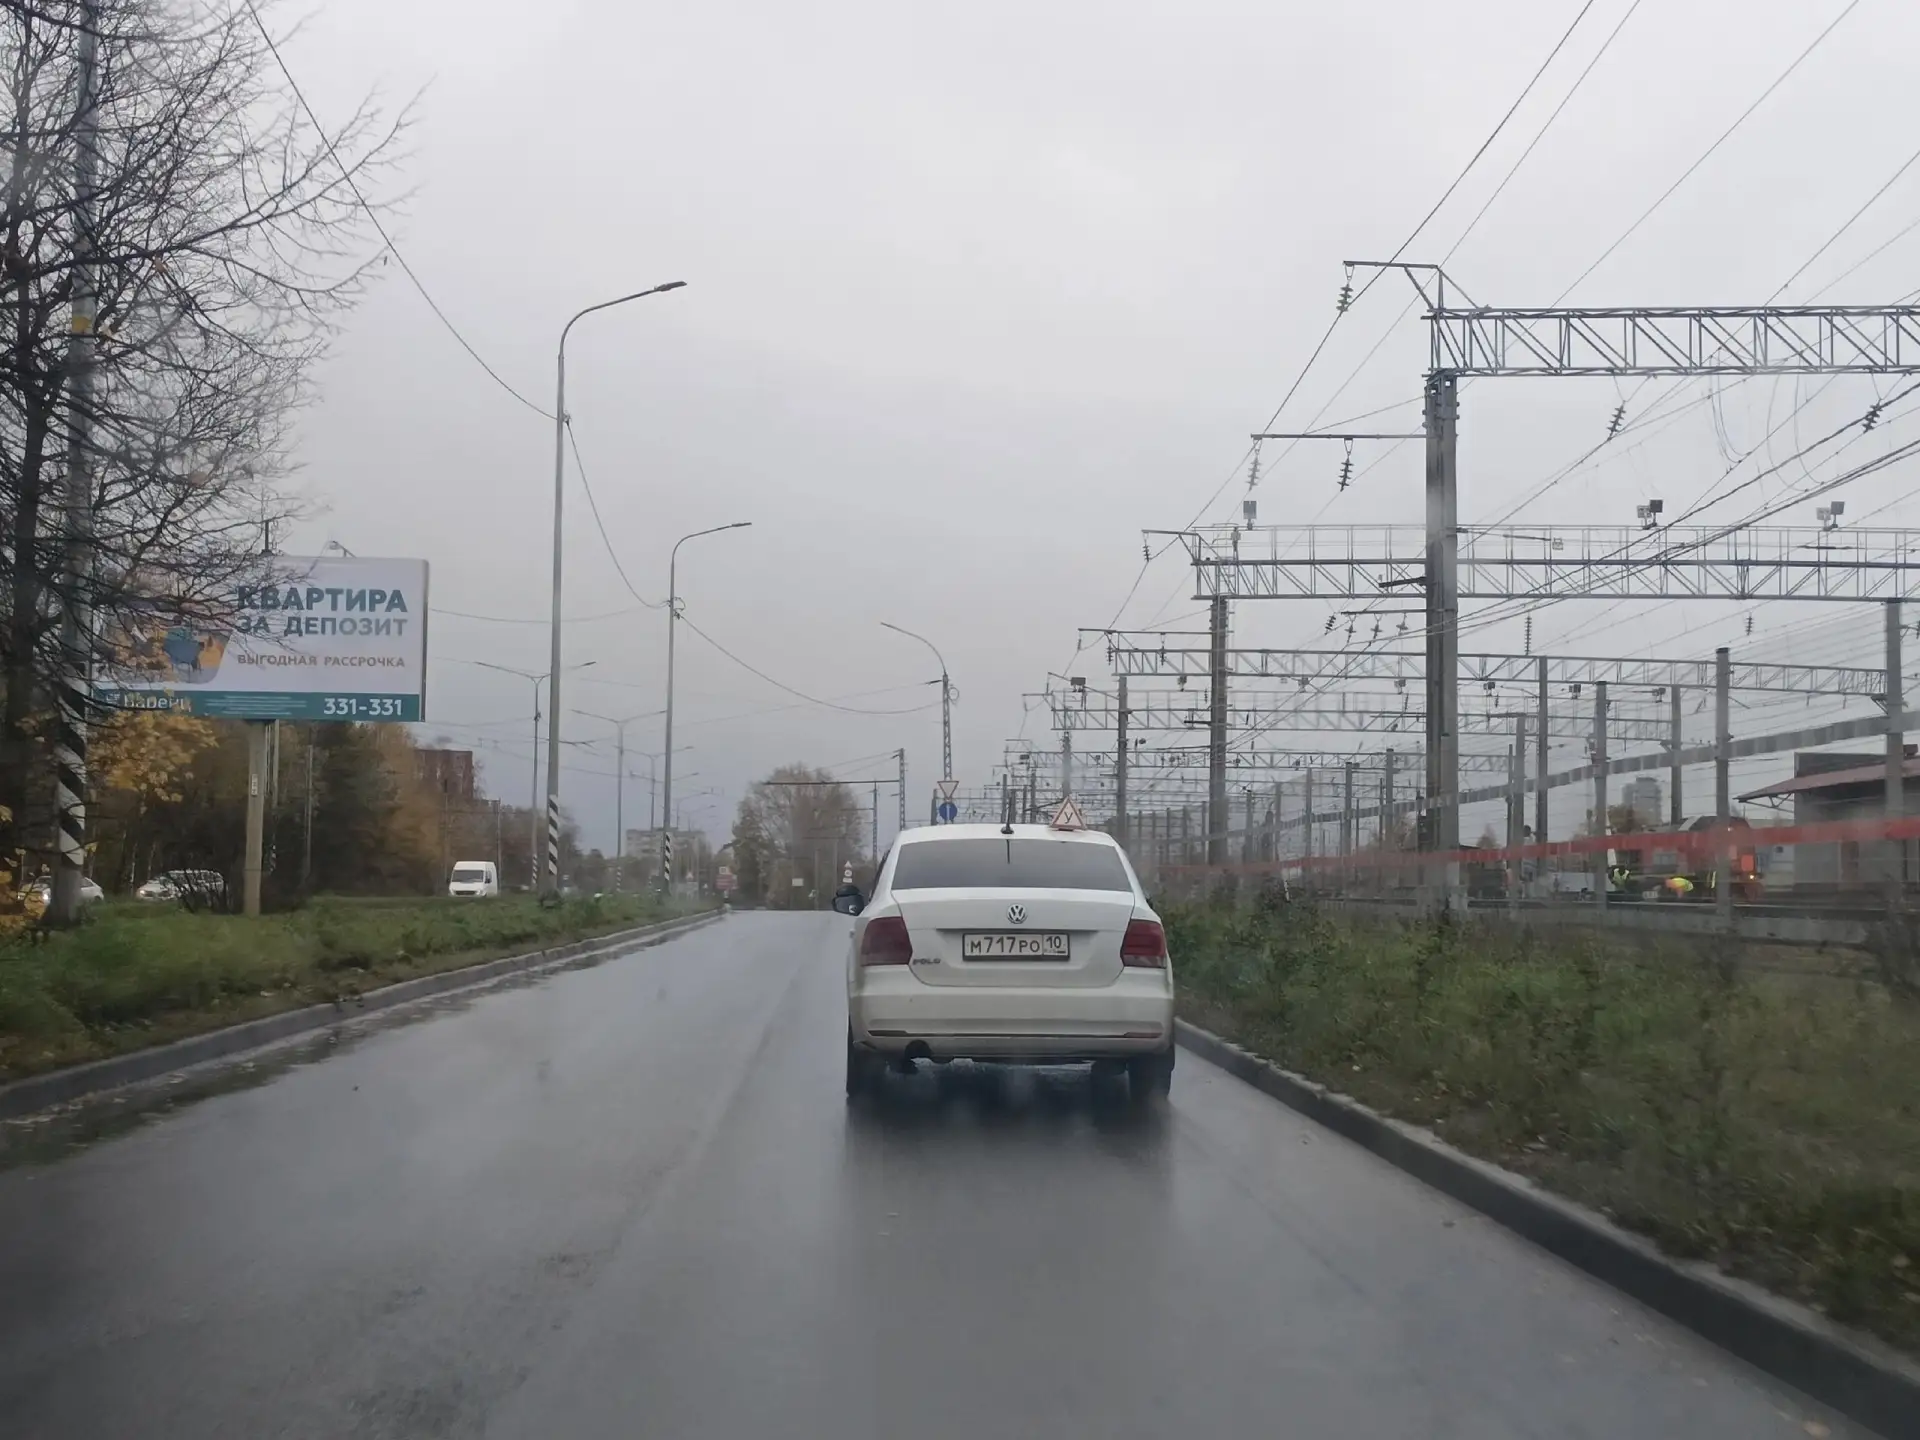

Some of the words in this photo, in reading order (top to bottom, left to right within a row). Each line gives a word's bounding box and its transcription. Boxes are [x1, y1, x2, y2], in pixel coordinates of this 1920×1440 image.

[237, 586, 408, 613] КВАРТИРА
[238, 615, 271, 634] ЗА
[283, 616, 408, 637] ДЕПОЗИТ
[237, 654, 317, 668] ВЫГОДНАЯ
[324, 656, 406, 668] РАССРОЧКА
[323, 698, 402, 716] 331-331
[970, 936, 1040, 954] М717РО
[1046, 936, 1062, 949] 10
